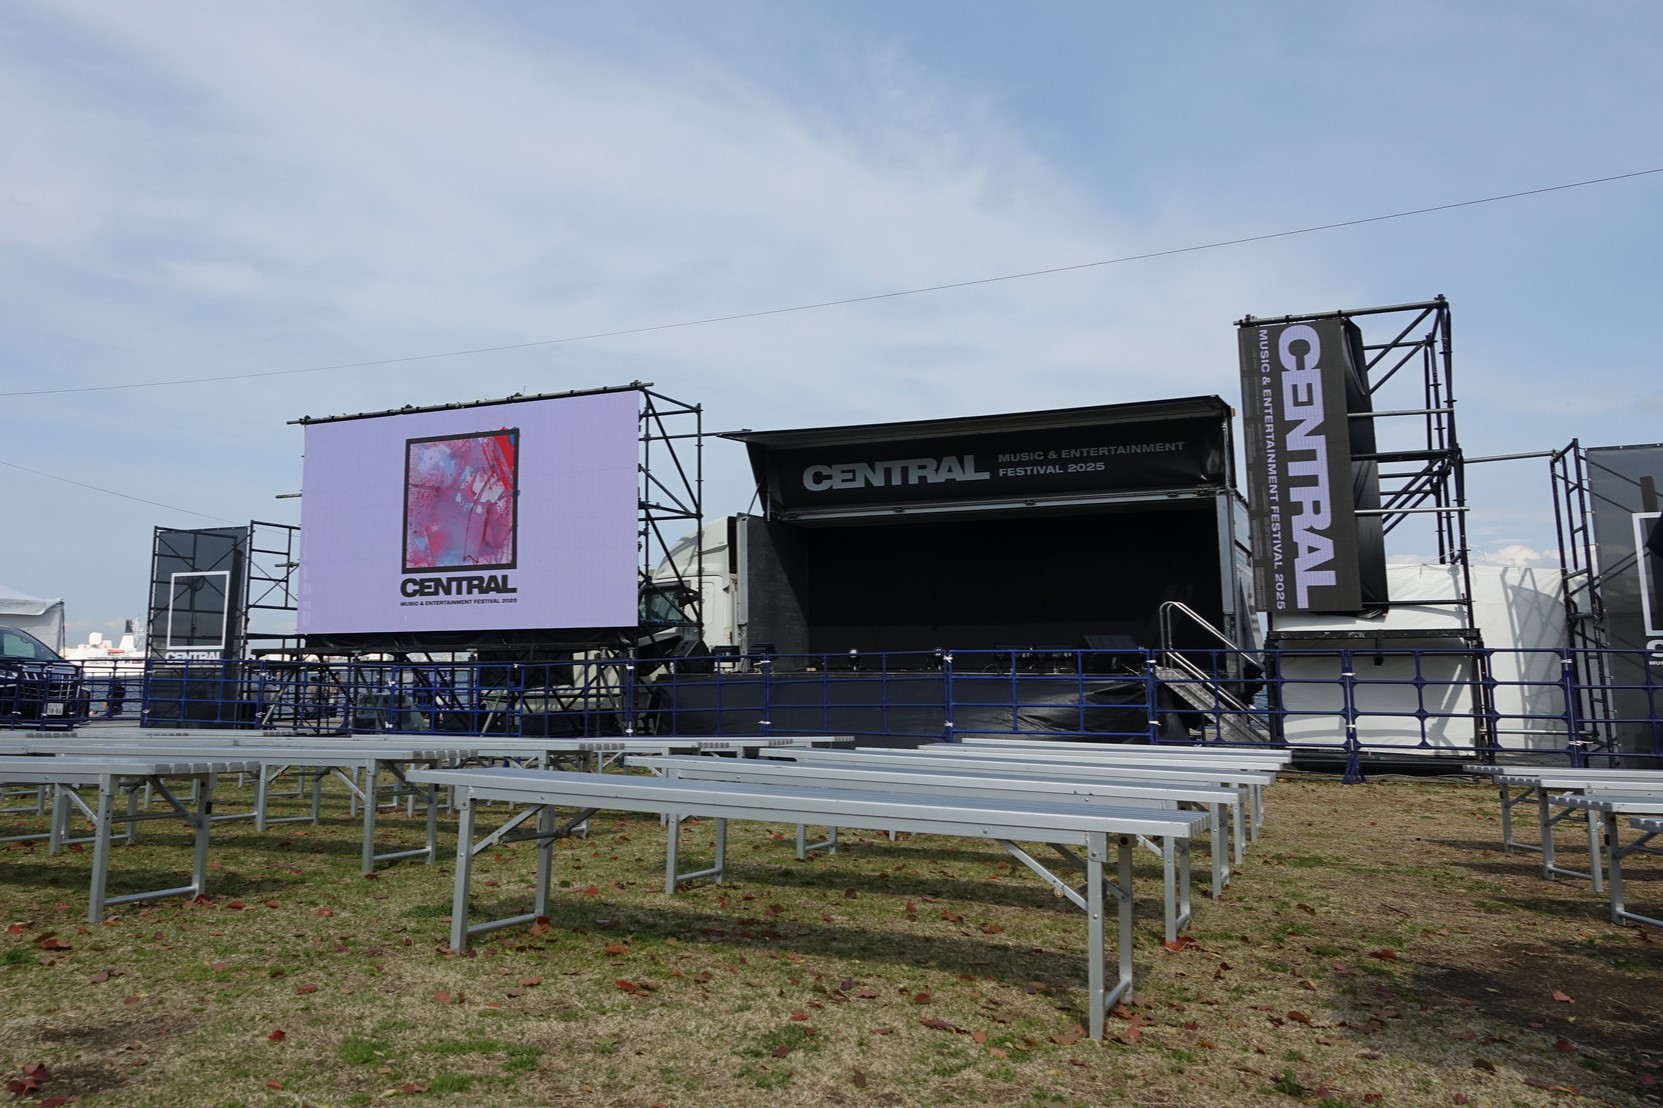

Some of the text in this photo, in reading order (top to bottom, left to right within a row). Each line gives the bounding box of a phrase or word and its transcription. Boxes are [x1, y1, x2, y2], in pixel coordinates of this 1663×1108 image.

[998, 441, 1185, 463] MUSIC & ENTERTAINMENT
[1278, 324, 1337, 609] CENTRAL
[802, 455, 991, 492] CENTRAL
[998, 461, 1105, 477] FESTIVAL 2025
[1258, 329, 1286, 610] MUSIC & ENTERTAINMENT FESTIVAL 2025
[400, 574, 518, 598] CENTRAL
